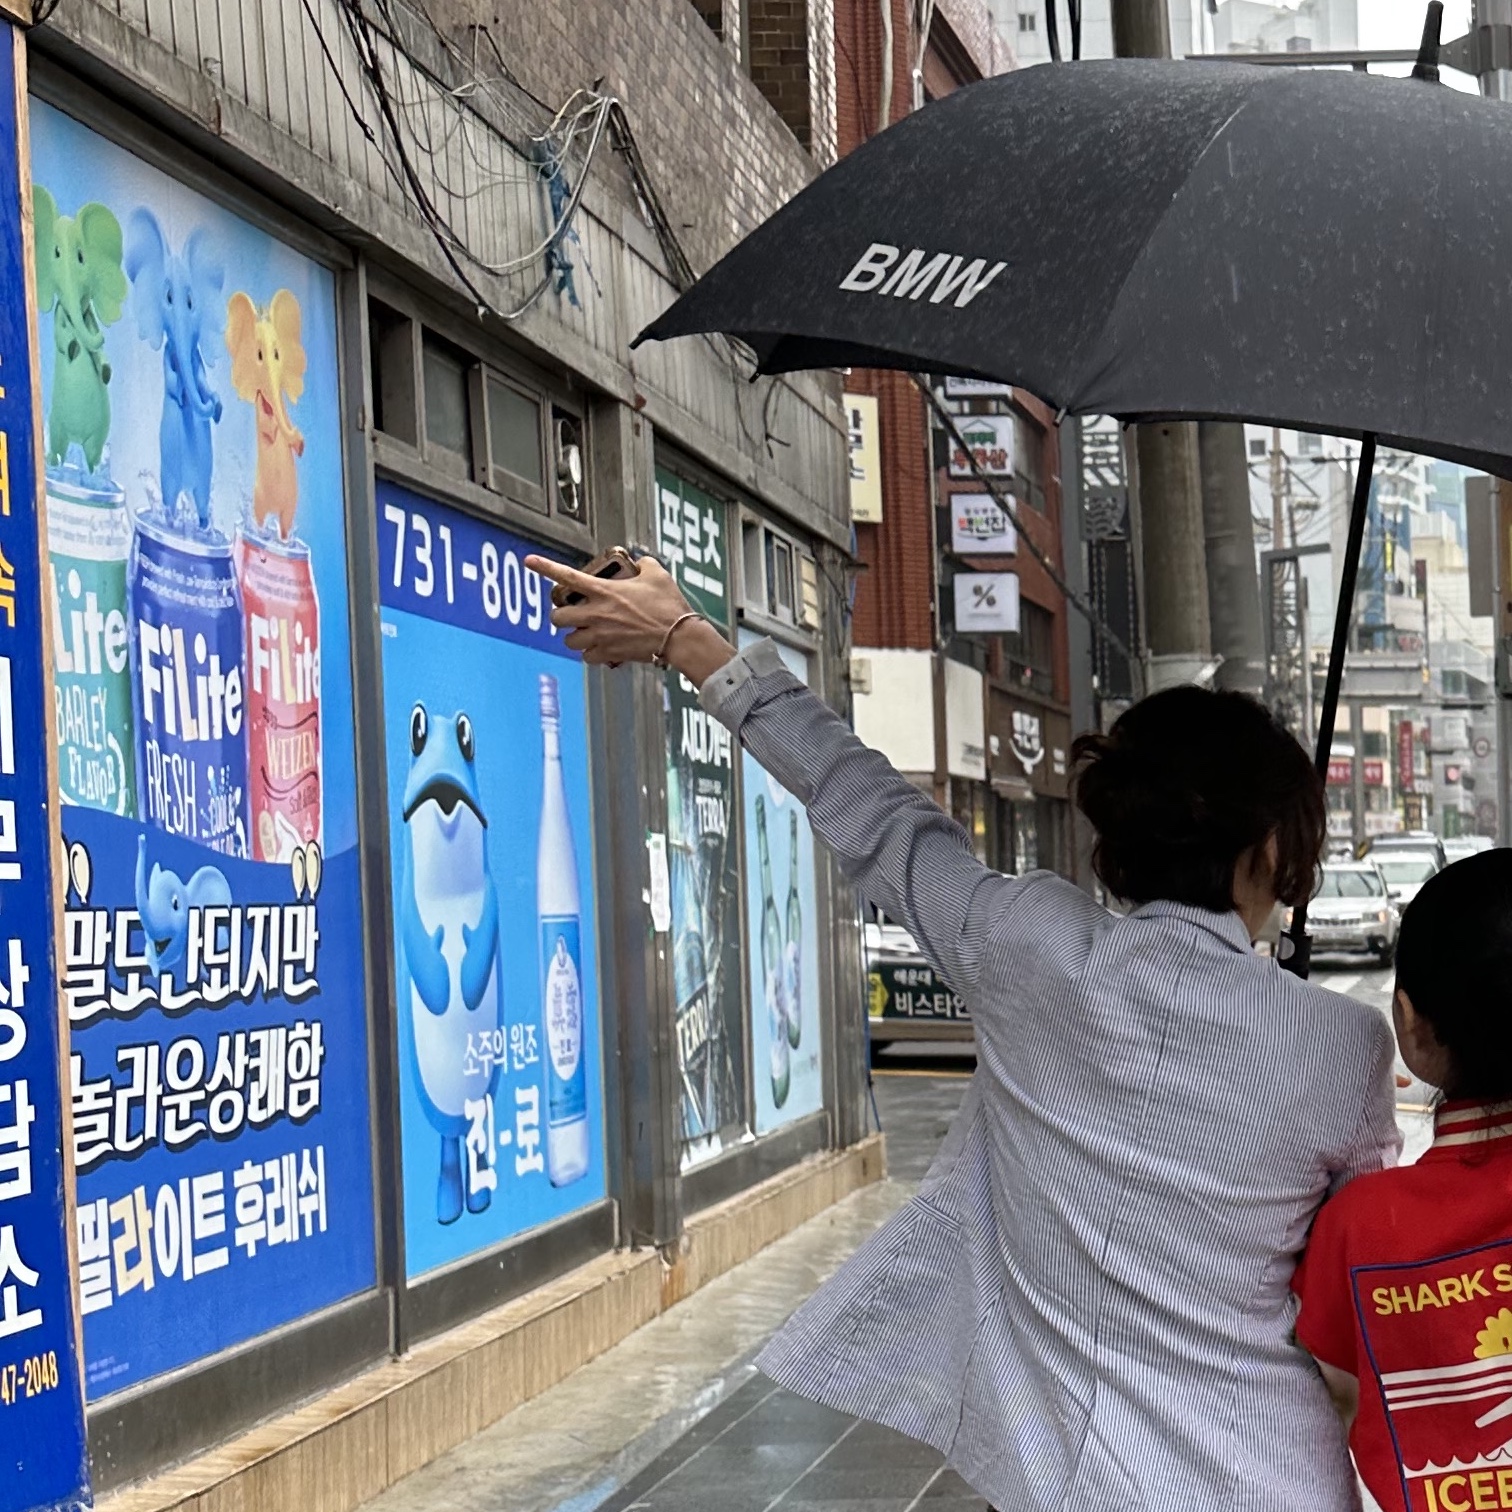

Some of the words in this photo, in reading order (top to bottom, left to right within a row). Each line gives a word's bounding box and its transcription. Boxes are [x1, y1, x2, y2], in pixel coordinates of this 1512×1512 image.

[838, 242, 1008, 308] BMW
[655, 482, 723, 598] 푸르츠
[138, 619, 243, 742] FiLite
[55, 684, 109, 752] BARLEY
[67, 748, 115, 806] FLAVOR
[145, 739, 197, 838] FRESH
[463, 1025, 508, 1078] 소주의
[510, 1024, 540, 1072] 원조
[75, 1169, 229, 1316] 필라이트
[233, 1145, 327, 1259] 후레쉬
[1372, 1268, 1492, 1317] SHARK
